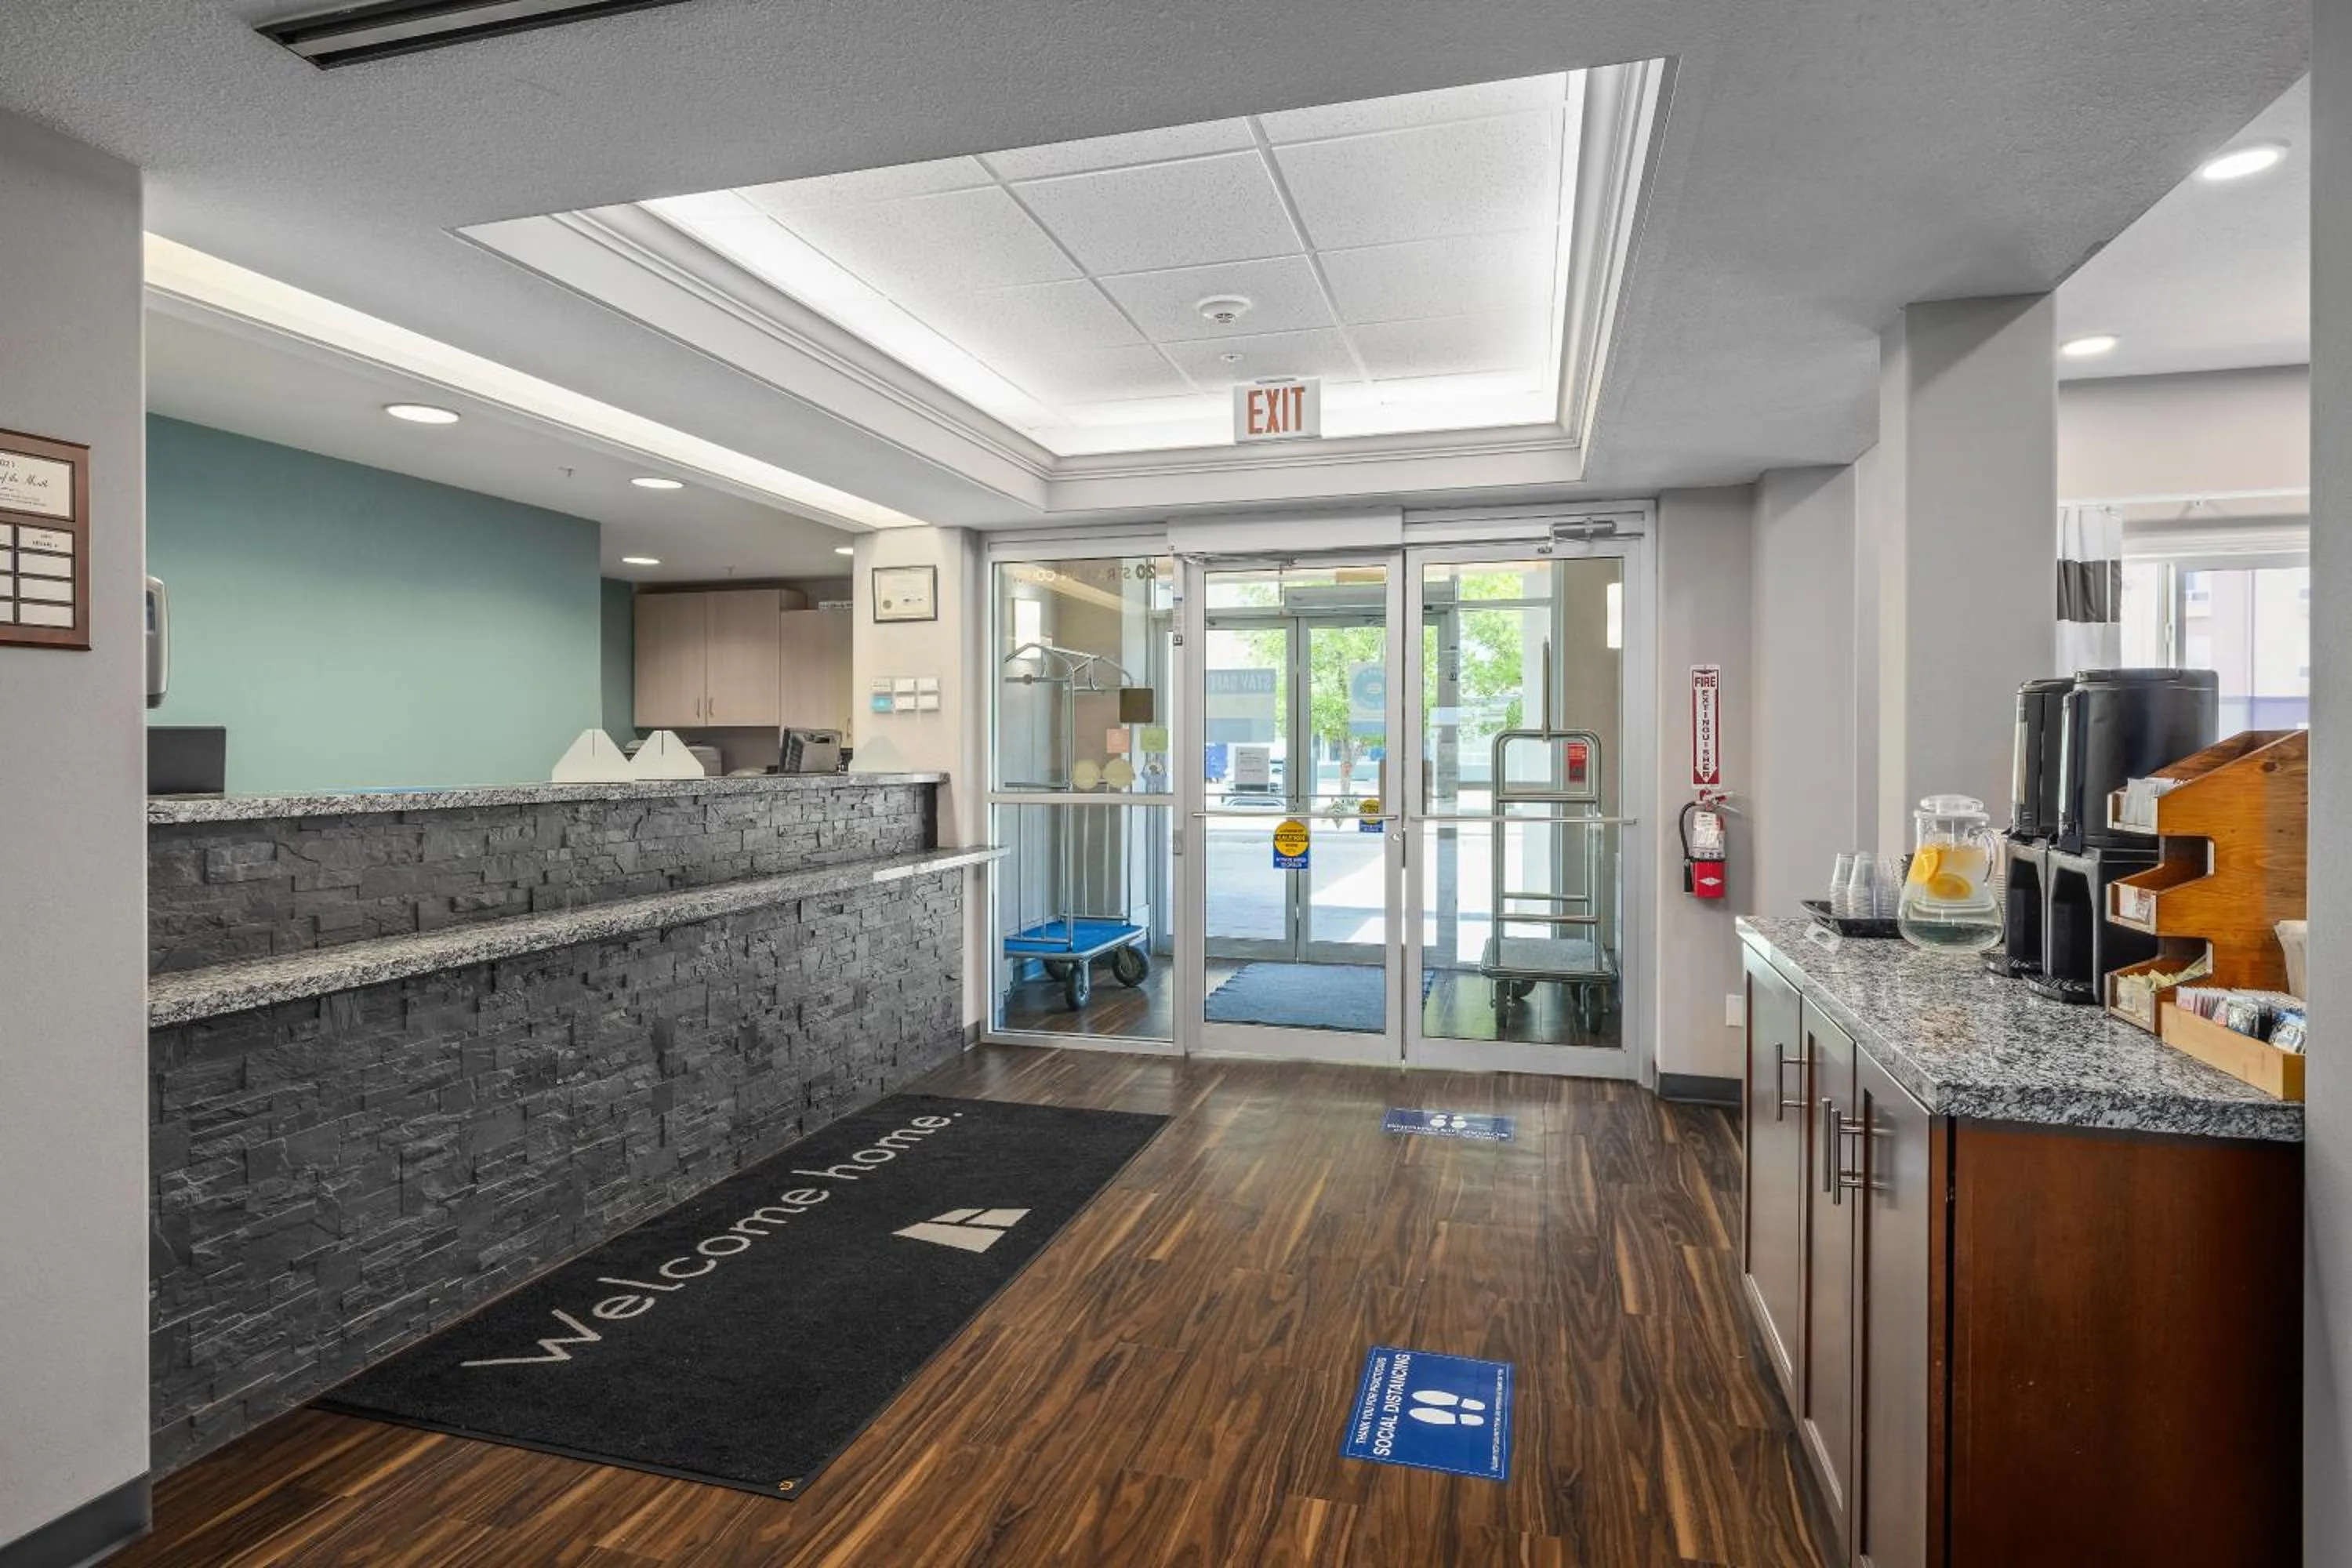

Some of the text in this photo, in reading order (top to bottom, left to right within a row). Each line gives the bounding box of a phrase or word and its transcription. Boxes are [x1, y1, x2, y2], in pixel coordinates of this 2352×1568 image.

[1247, 387, 1305, 434] EXIT
[1694, 677, 1716, 688] FIRE
[460, 1110, 964, 1367] Welcome home.
[1373, 1354, 1410, 1456] SOCIAL DISTANCING
